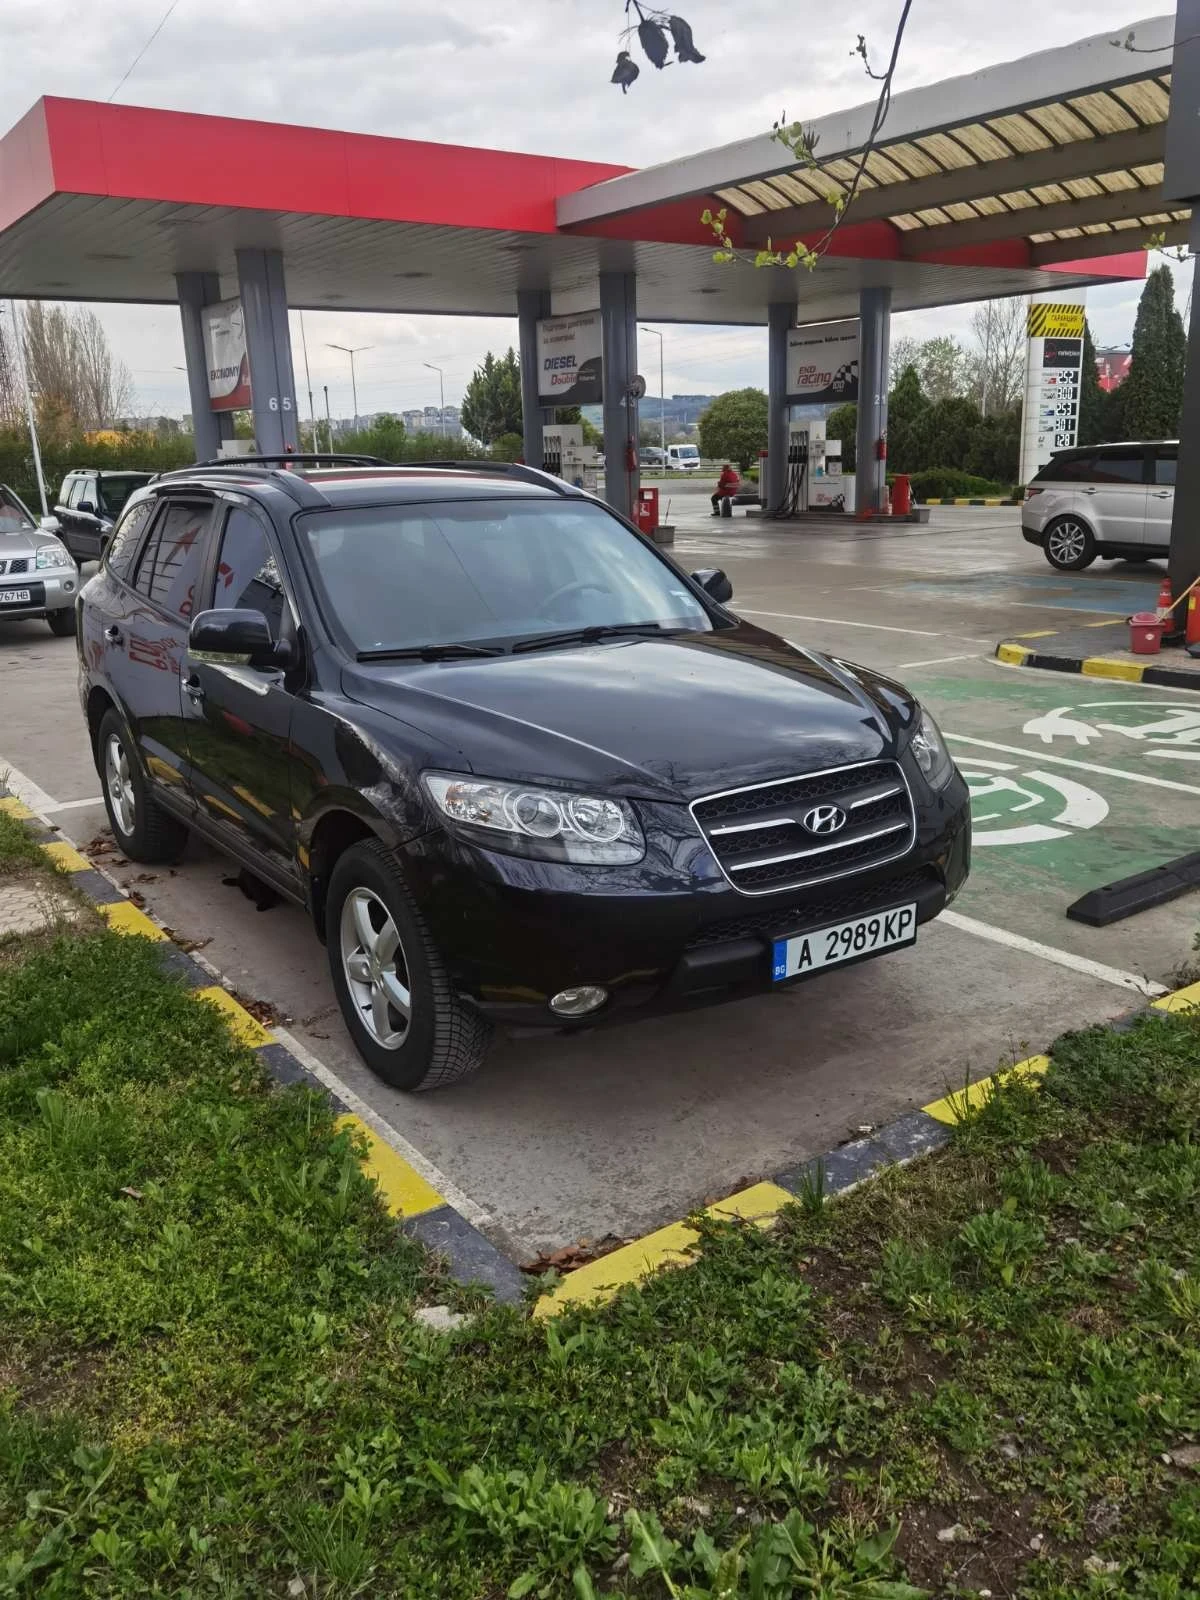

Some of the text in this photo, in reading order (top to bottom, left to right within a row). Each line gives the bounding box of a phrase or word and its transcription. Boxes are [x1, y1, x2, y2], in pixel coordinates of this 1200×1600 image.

[543, 355, 578, 371] DIESEL
[210, 365, 240, 381] EKONOMY
[797, 373, 832, 387] racing
[269, 397, 291, 411] 6 5
[798, 938, 812, 969] A
[775, 964, 786, 976] BG
